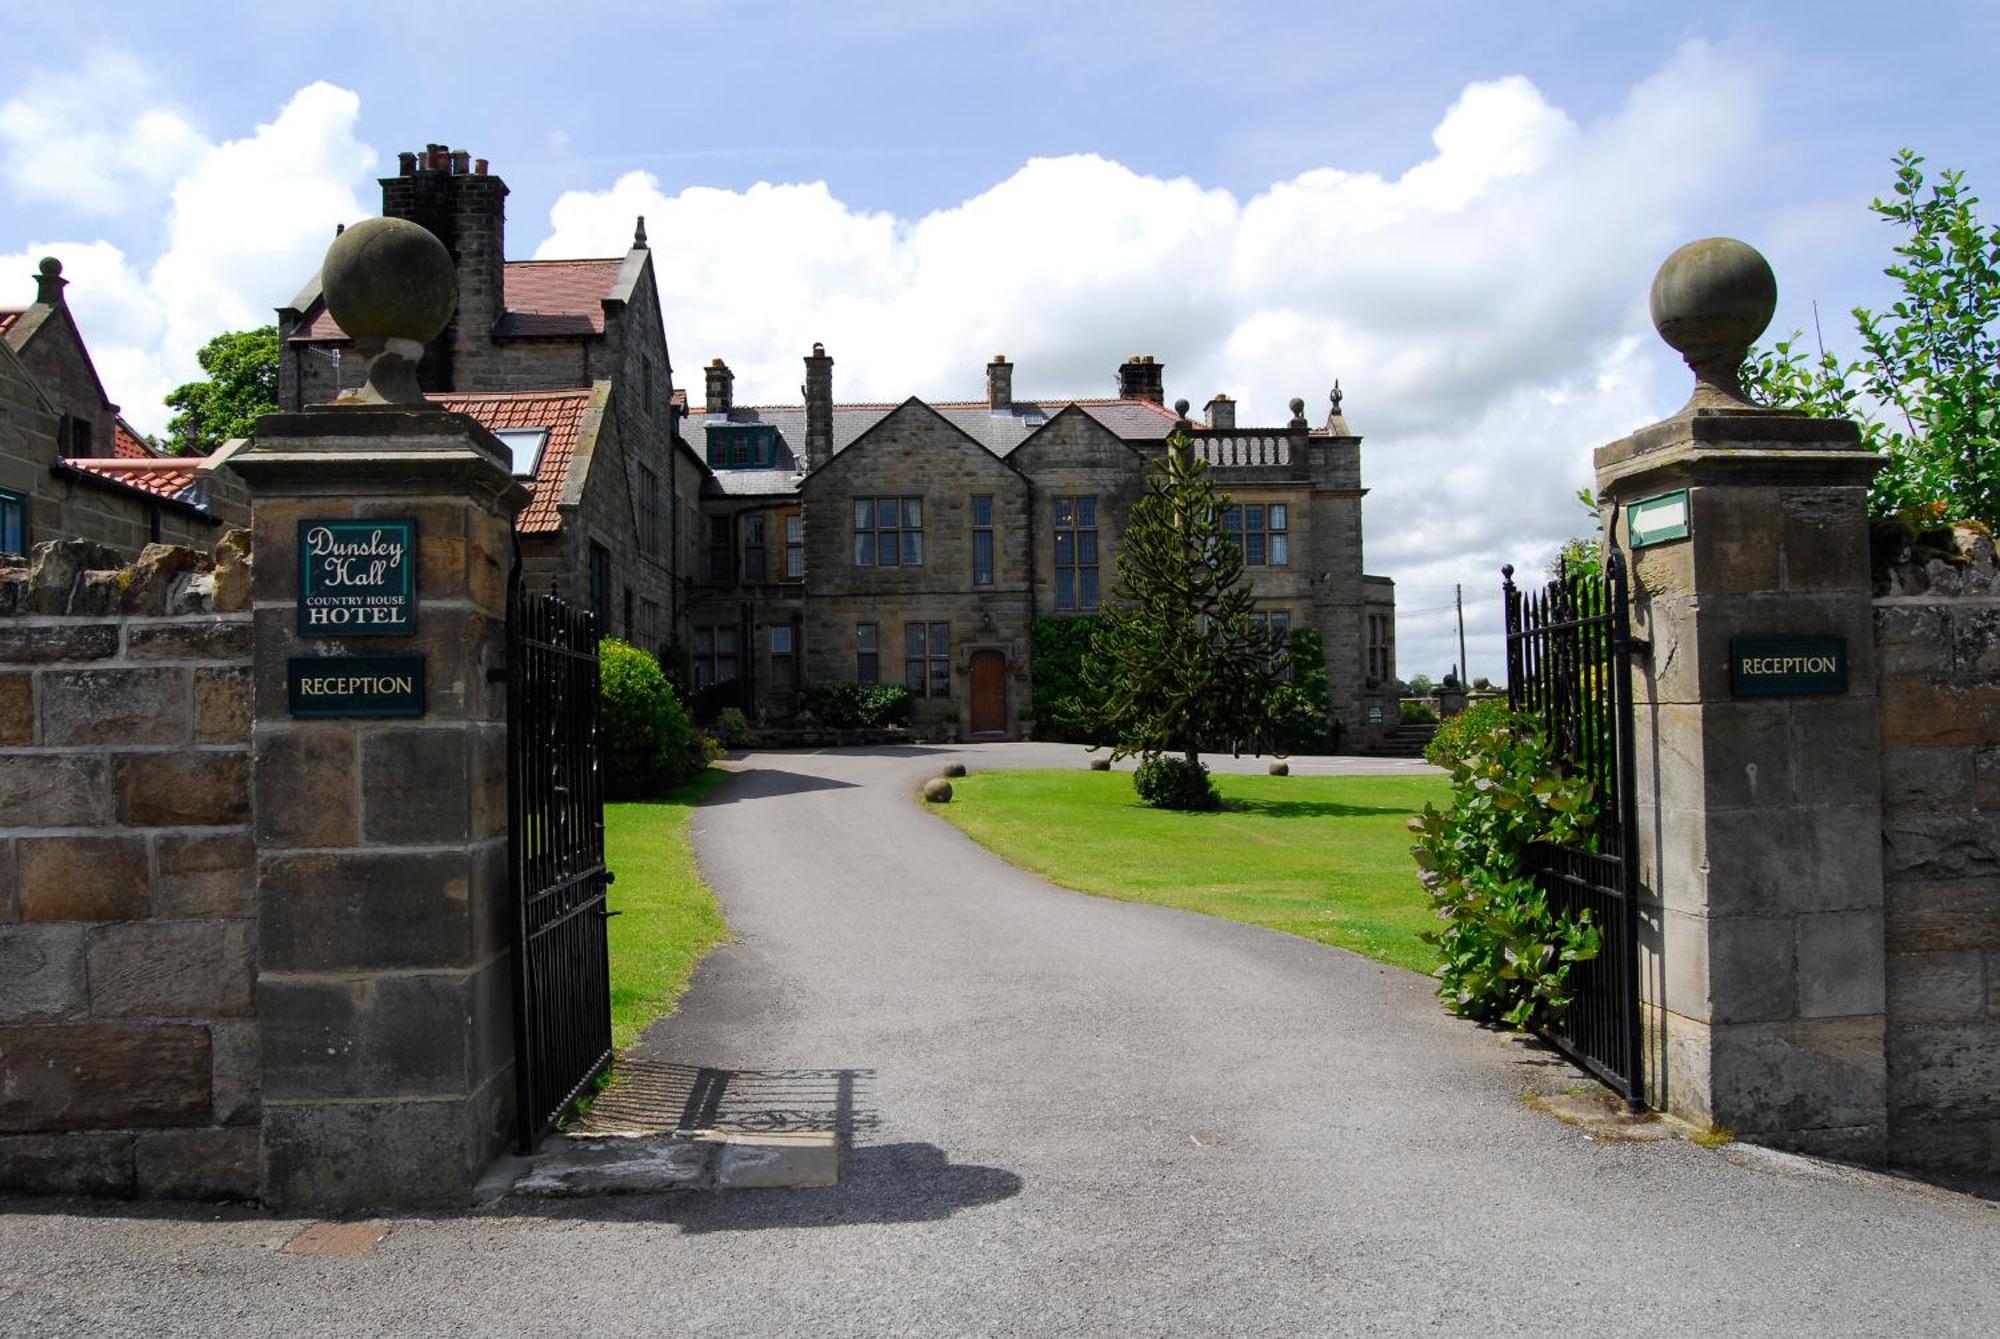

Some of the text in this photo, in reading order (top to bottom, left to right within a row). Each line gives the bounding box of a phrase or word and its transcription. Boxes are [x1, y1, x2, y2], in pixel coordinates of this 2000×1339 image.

[307, 526, 403, 567] Dunsley
[324, 557, 386, 586] Hall
[307, 595, 406, 606] COUNTRY HOUSE
[309, 607, 406, 625] HOTEL
[1742, 657, 1836, 675] RECEPTION
[300, 677, 412, 695] RECEPTION
